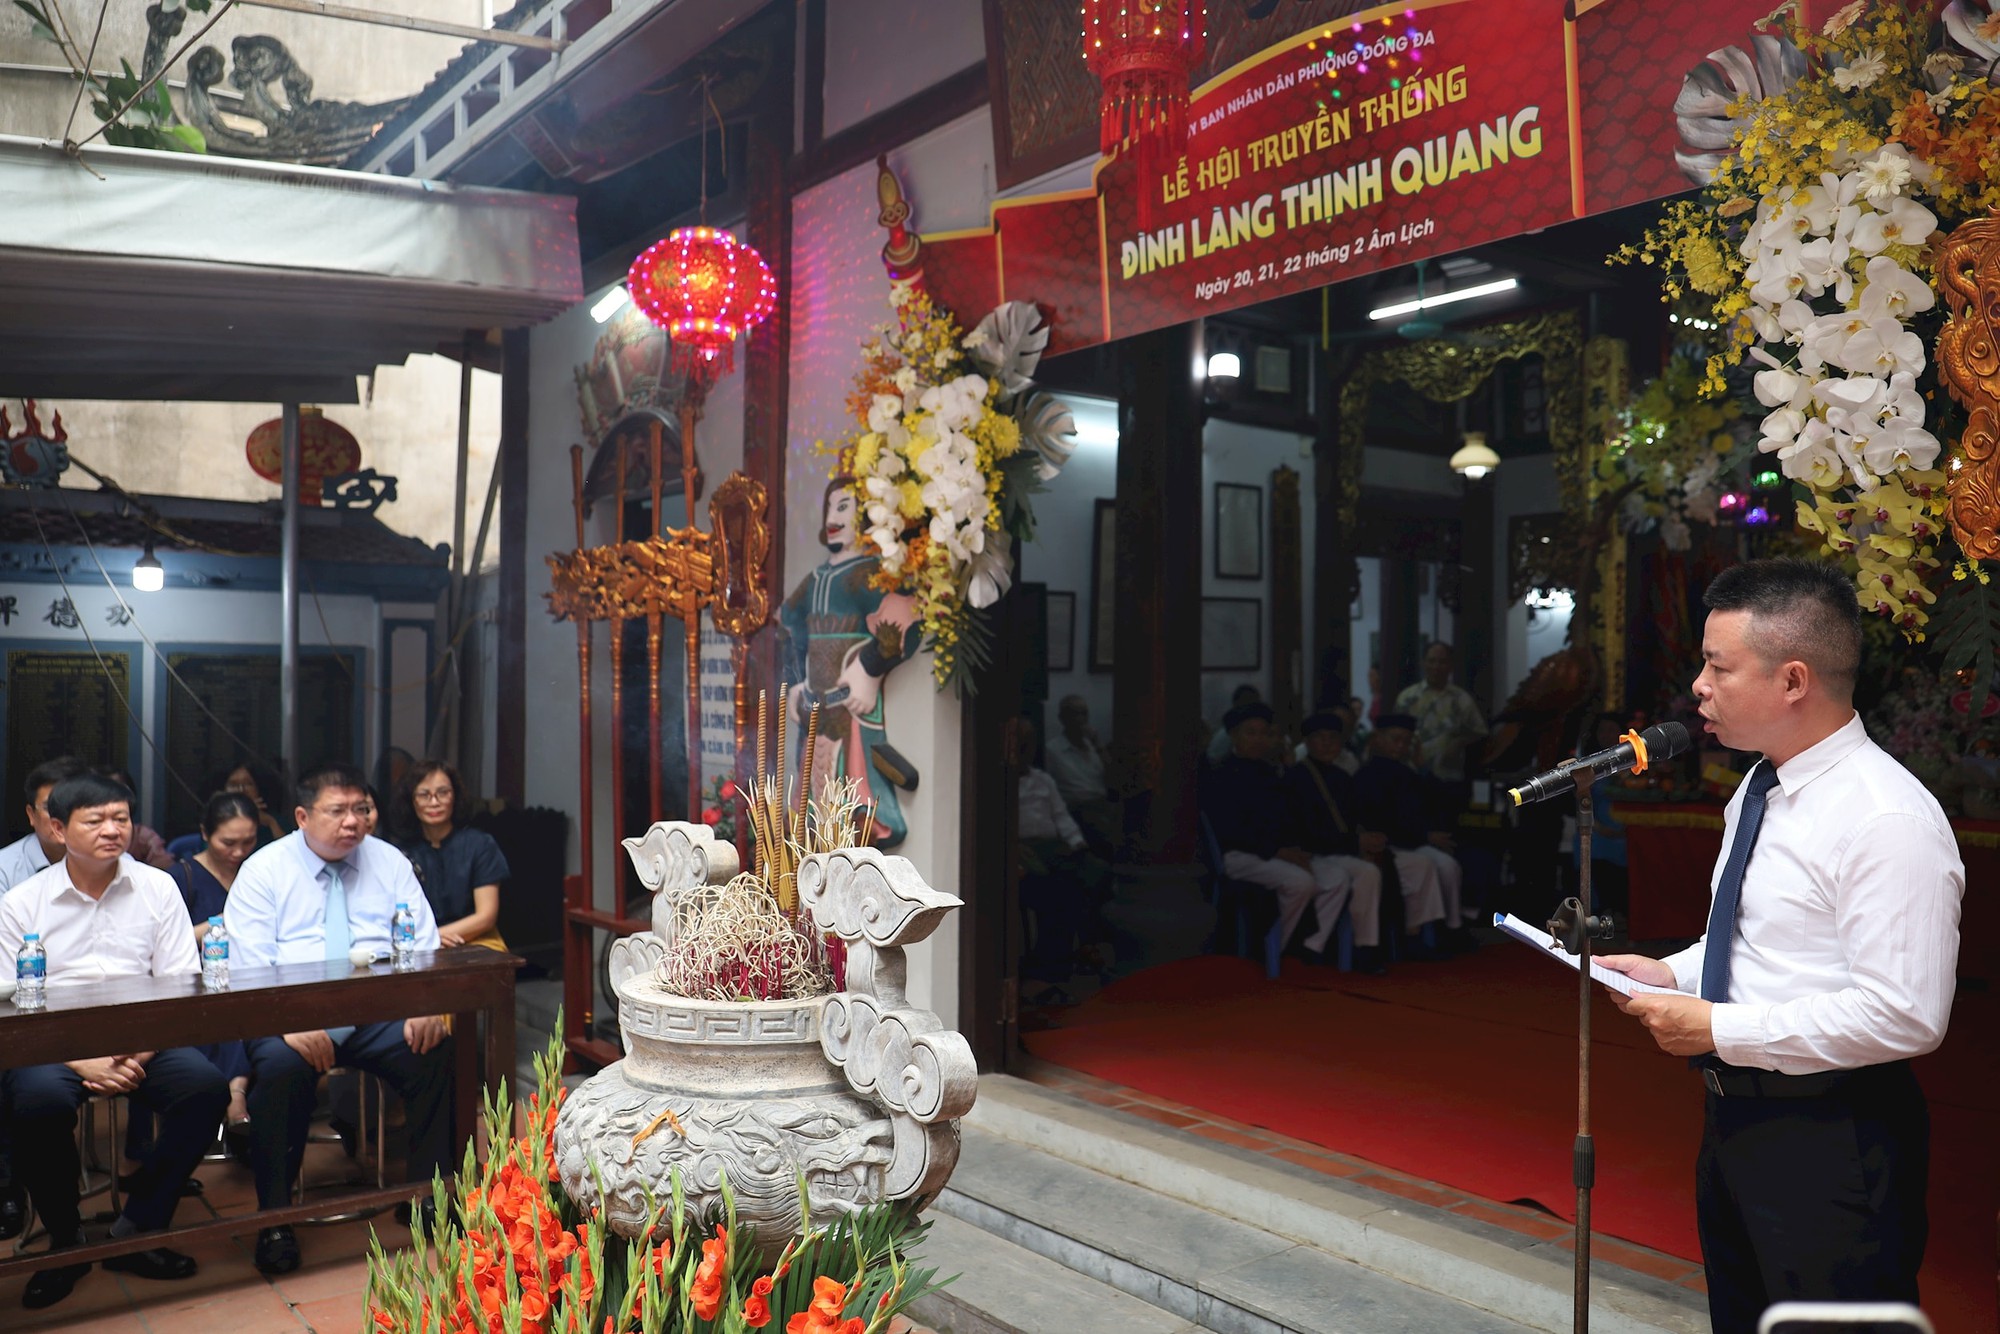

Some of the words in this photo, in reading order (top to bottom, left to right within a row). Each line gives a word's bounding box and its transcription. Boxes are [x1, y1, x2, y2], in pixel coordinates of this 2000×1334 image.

[1162, 155, 1191, 204] LỄ
[1196, 146, 1241, 191] HỘI
[1247, 105, 1352, 173] TRUYỀN
[1359, 64, 1467, 133] THỐNG
[1187, 121, 1197, 140] Y
[1200, 105, 1225, 131] BAN
[1227, 87, 1263, 115] NHÂN
[1266, 72, 1295, 96] DÂN
[1362, 34, 1408, 61] ĐỐNG
[1413, 29, 1435, 48] ĐA
[1121, 222, 1186, 280] ĐÌNH
[1191, 193, 1275, 258] LÀNG
[1281, 156, 1383, 230] THỊNH
[1390, 106, 1542, 195] QUANG
[1195, 276, 1231, 300] Ngày
[1233, 269, 1253, 288] 20,
[1258, 262, 1279, 282] 21,
[1283, 255, 1302, 275] 22
[1305, 243, 1350, 268] tháng
[1354, 237, 1364, 255] 2
[1368, 228, 1396, 251] Âm
[1400, 218, 1434, 245] Lịch
